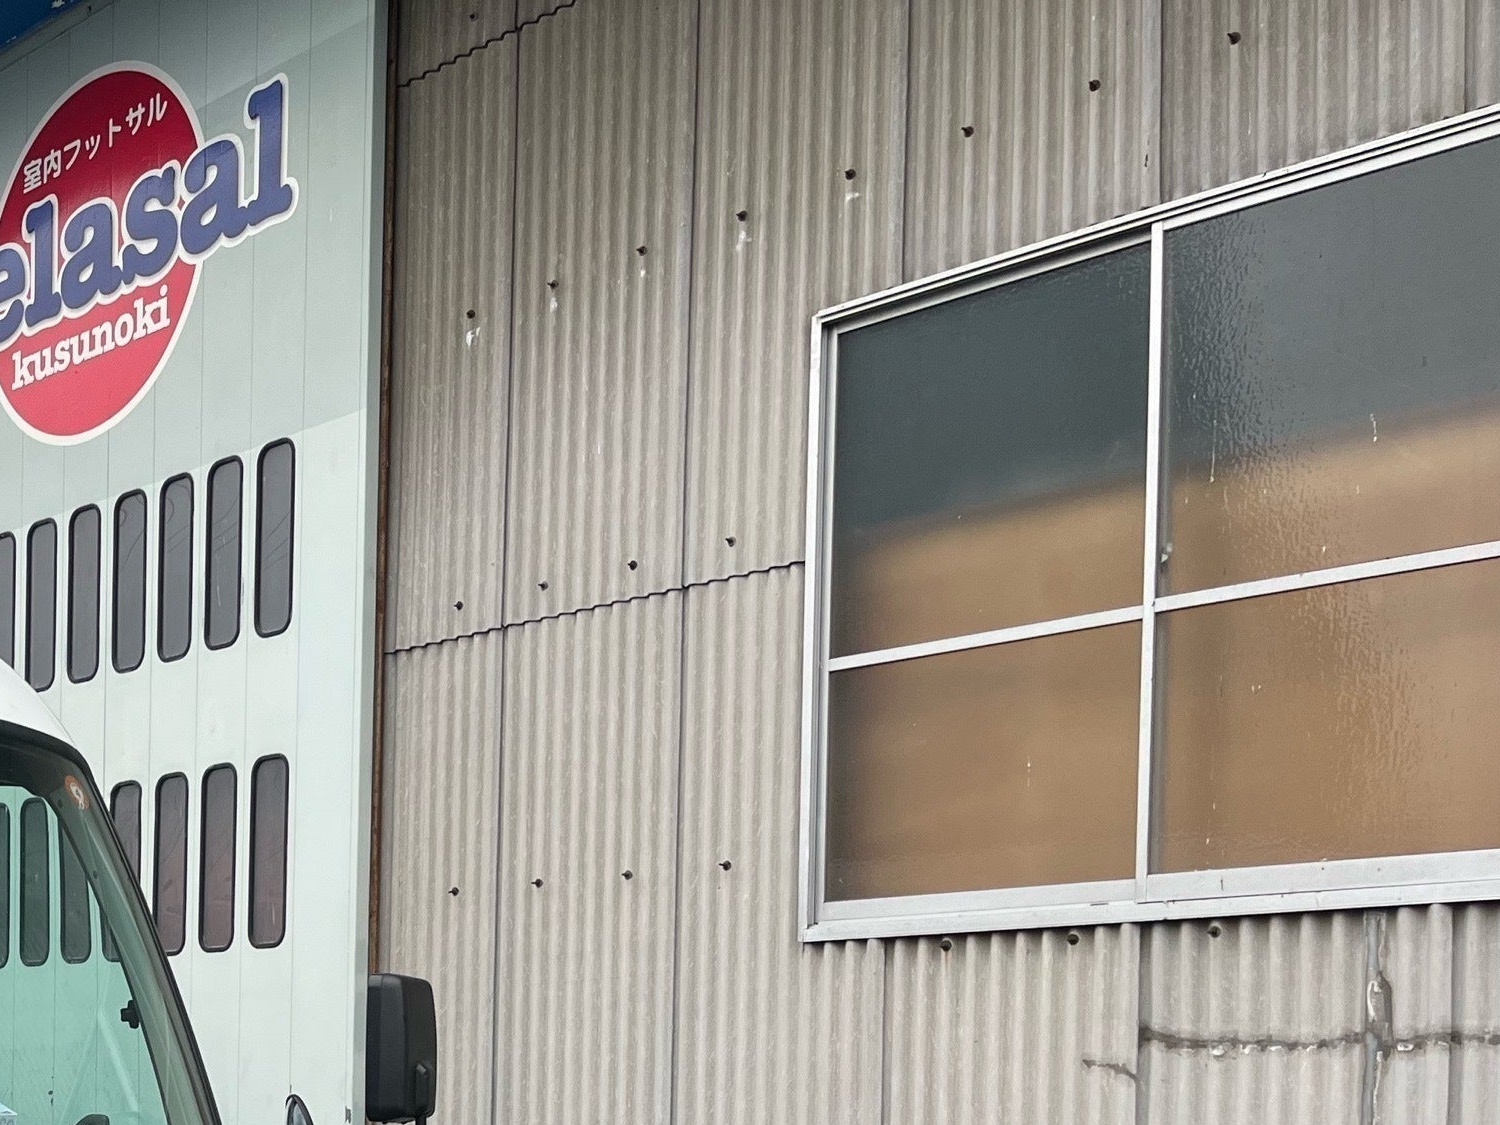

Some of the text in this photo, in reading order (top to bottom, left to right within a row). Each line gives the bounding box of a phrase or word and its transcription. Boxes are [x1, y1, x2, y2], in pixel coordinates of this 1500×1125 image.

[23, 93, 168, 194] 室内フットサル
[11, 285, 171, 390] kusunoki
